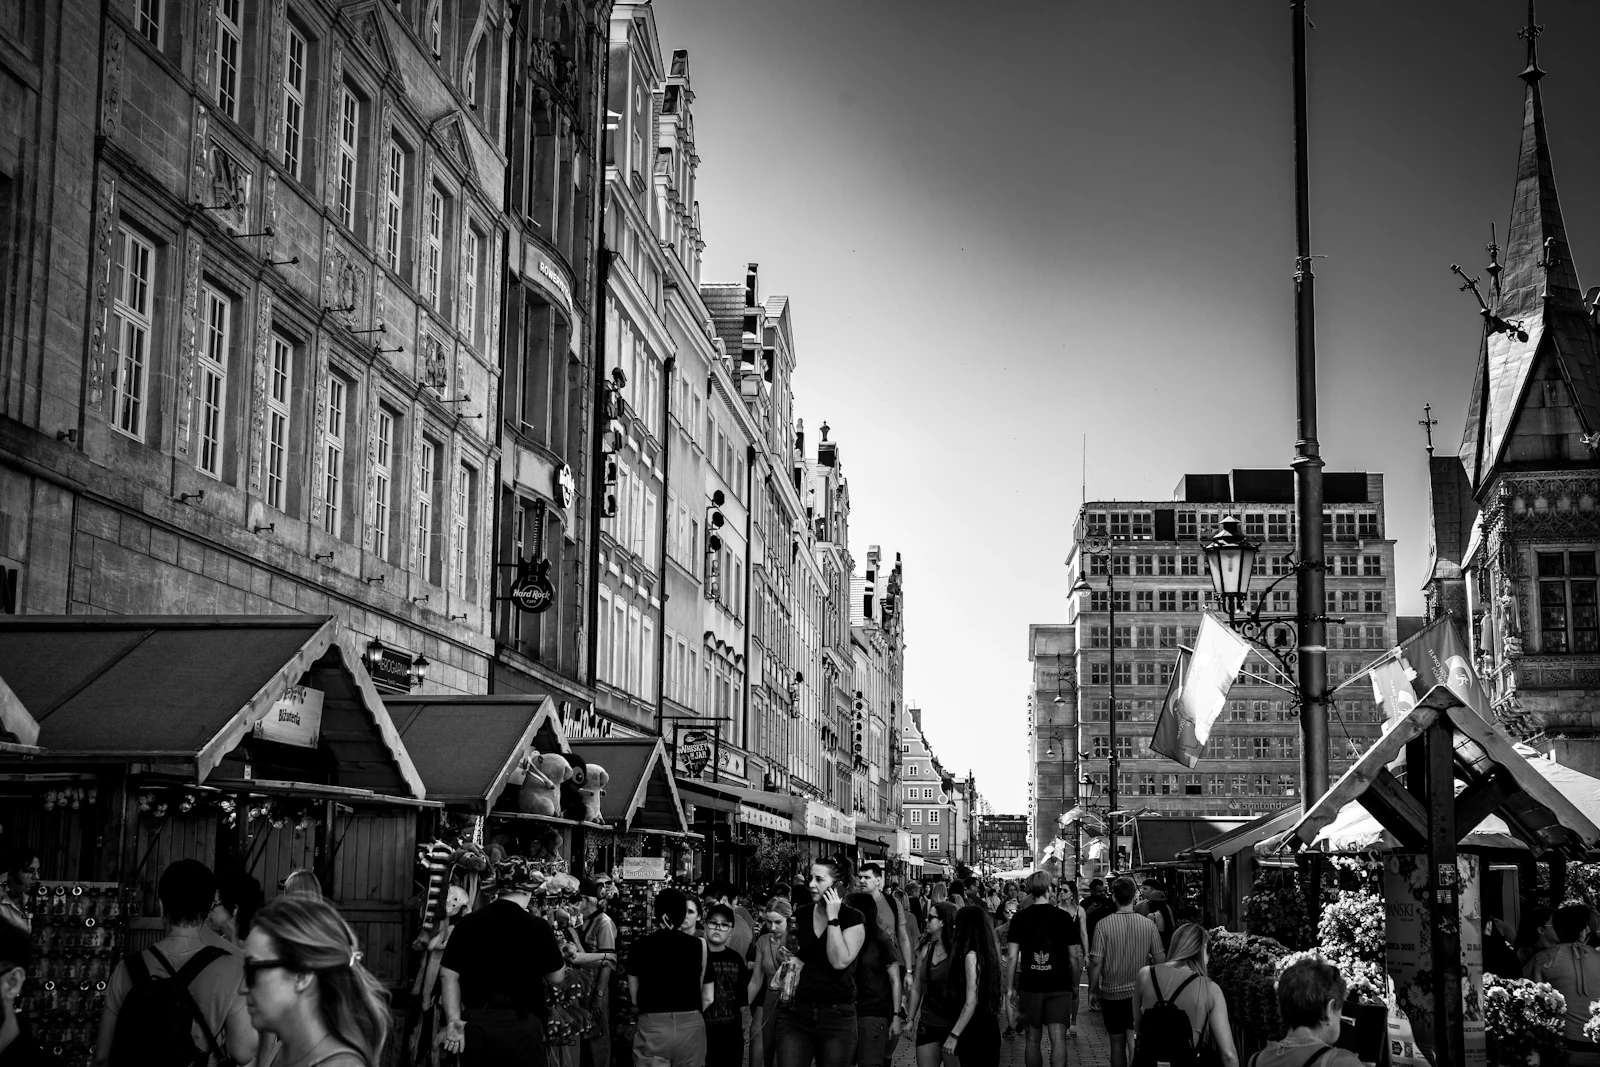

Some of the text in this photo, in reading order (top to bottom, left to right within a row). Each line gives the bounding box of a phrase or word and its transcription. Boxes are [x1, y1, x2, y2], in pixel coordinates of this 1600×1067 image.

[512, 588, 551, 601] Hard Rock
[278, 708, 301, 726] Biżuteria
[677, 743, 708, 754] WHISKEY
[694, 750, 709, 760] JAR
[1242, 801, 1289, 810] Santander
[1401, 943, 1415, 951] 2025
